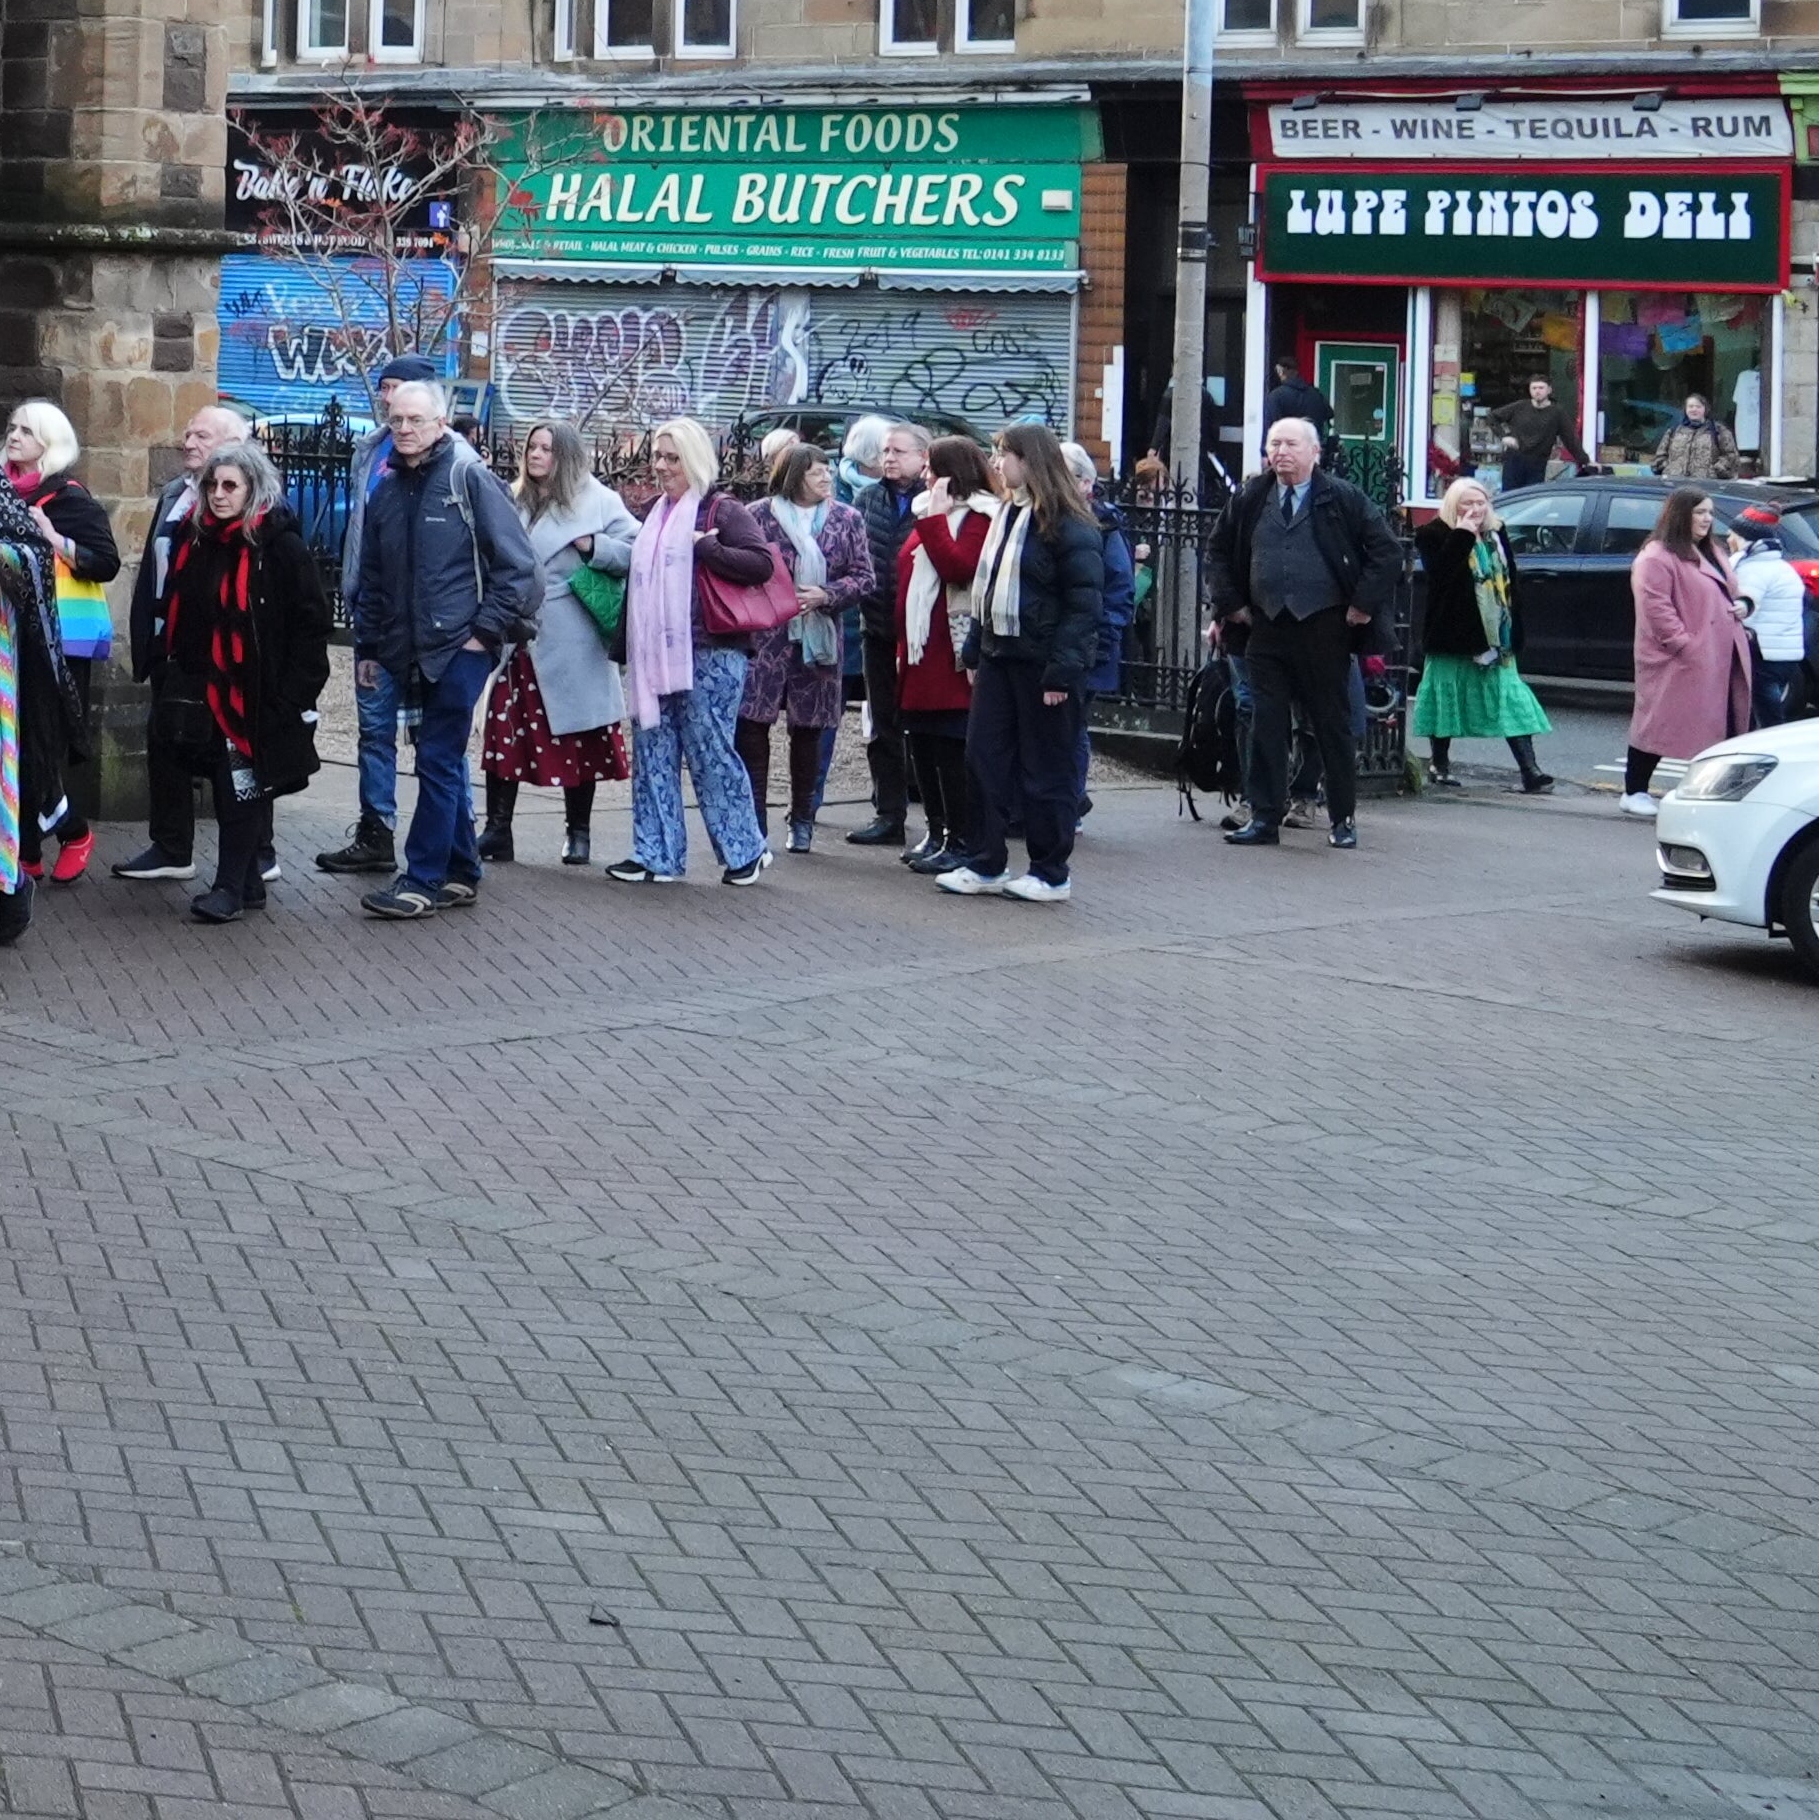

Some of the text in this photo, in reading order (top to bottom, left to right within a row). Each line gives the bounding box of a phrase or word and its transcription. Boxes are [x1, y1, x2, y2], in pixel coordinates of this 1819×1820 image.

[603, 113, 960, 153] ORIENTAL FOODS
[1280, 118, 1363, 140] BEER
[1390, 118, 1476, 140] WINE
[1506, 116, 1659, 140] TEQUILA
[1690, 115, 1773, 138] RUM
[545, 173, 1027, 228] HALAL BUTCHERS
[1287, 188, 1752, 240] LUPE PINTOS DELI
[590, 240, 618, 252] HALAL
[620, 241, 646, 253] MEAT
[656, 242, 697, 255] CHICKEN
[704, 243, 739, 256] PULSES
[746, 244, 782, 257] GRAINS
[790, 245, 814, 258] RICE
[823, 246, 854, 259] FRESH
[857, 246, 887, 259] FRUIT
[900, 247, 960, 260] VEGETABLES
